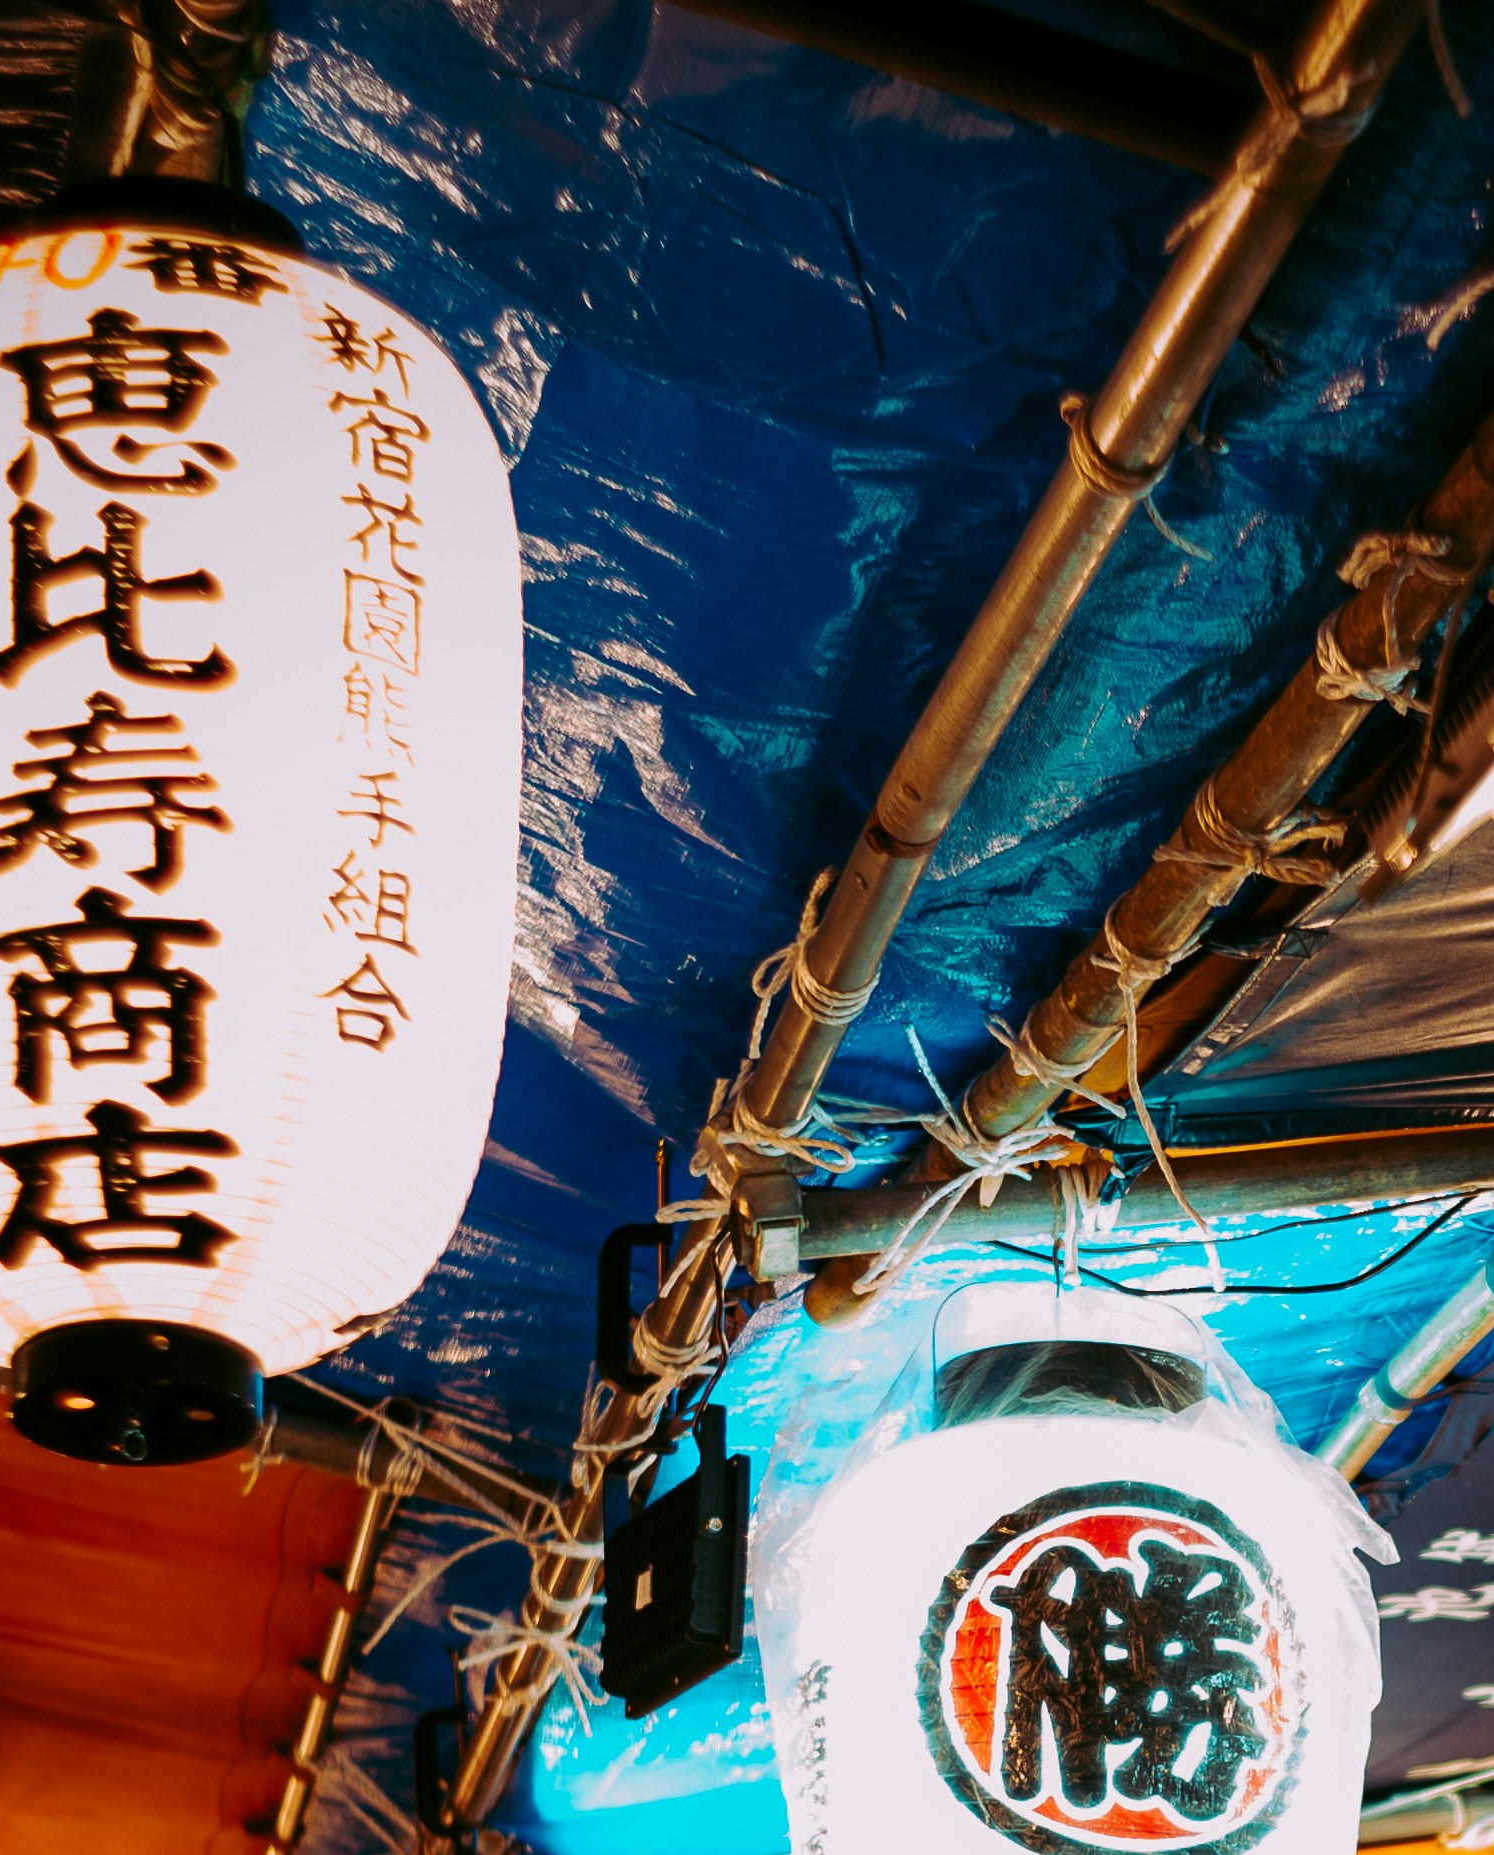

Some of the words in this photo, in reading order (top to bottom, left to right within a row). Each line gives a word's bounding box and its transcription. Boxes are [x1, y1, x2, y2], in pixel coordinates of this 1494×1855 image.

[311, 302, 434, 1054] 新宿花園熊手組合
[989, 1537, 1267, 1822] 勝
